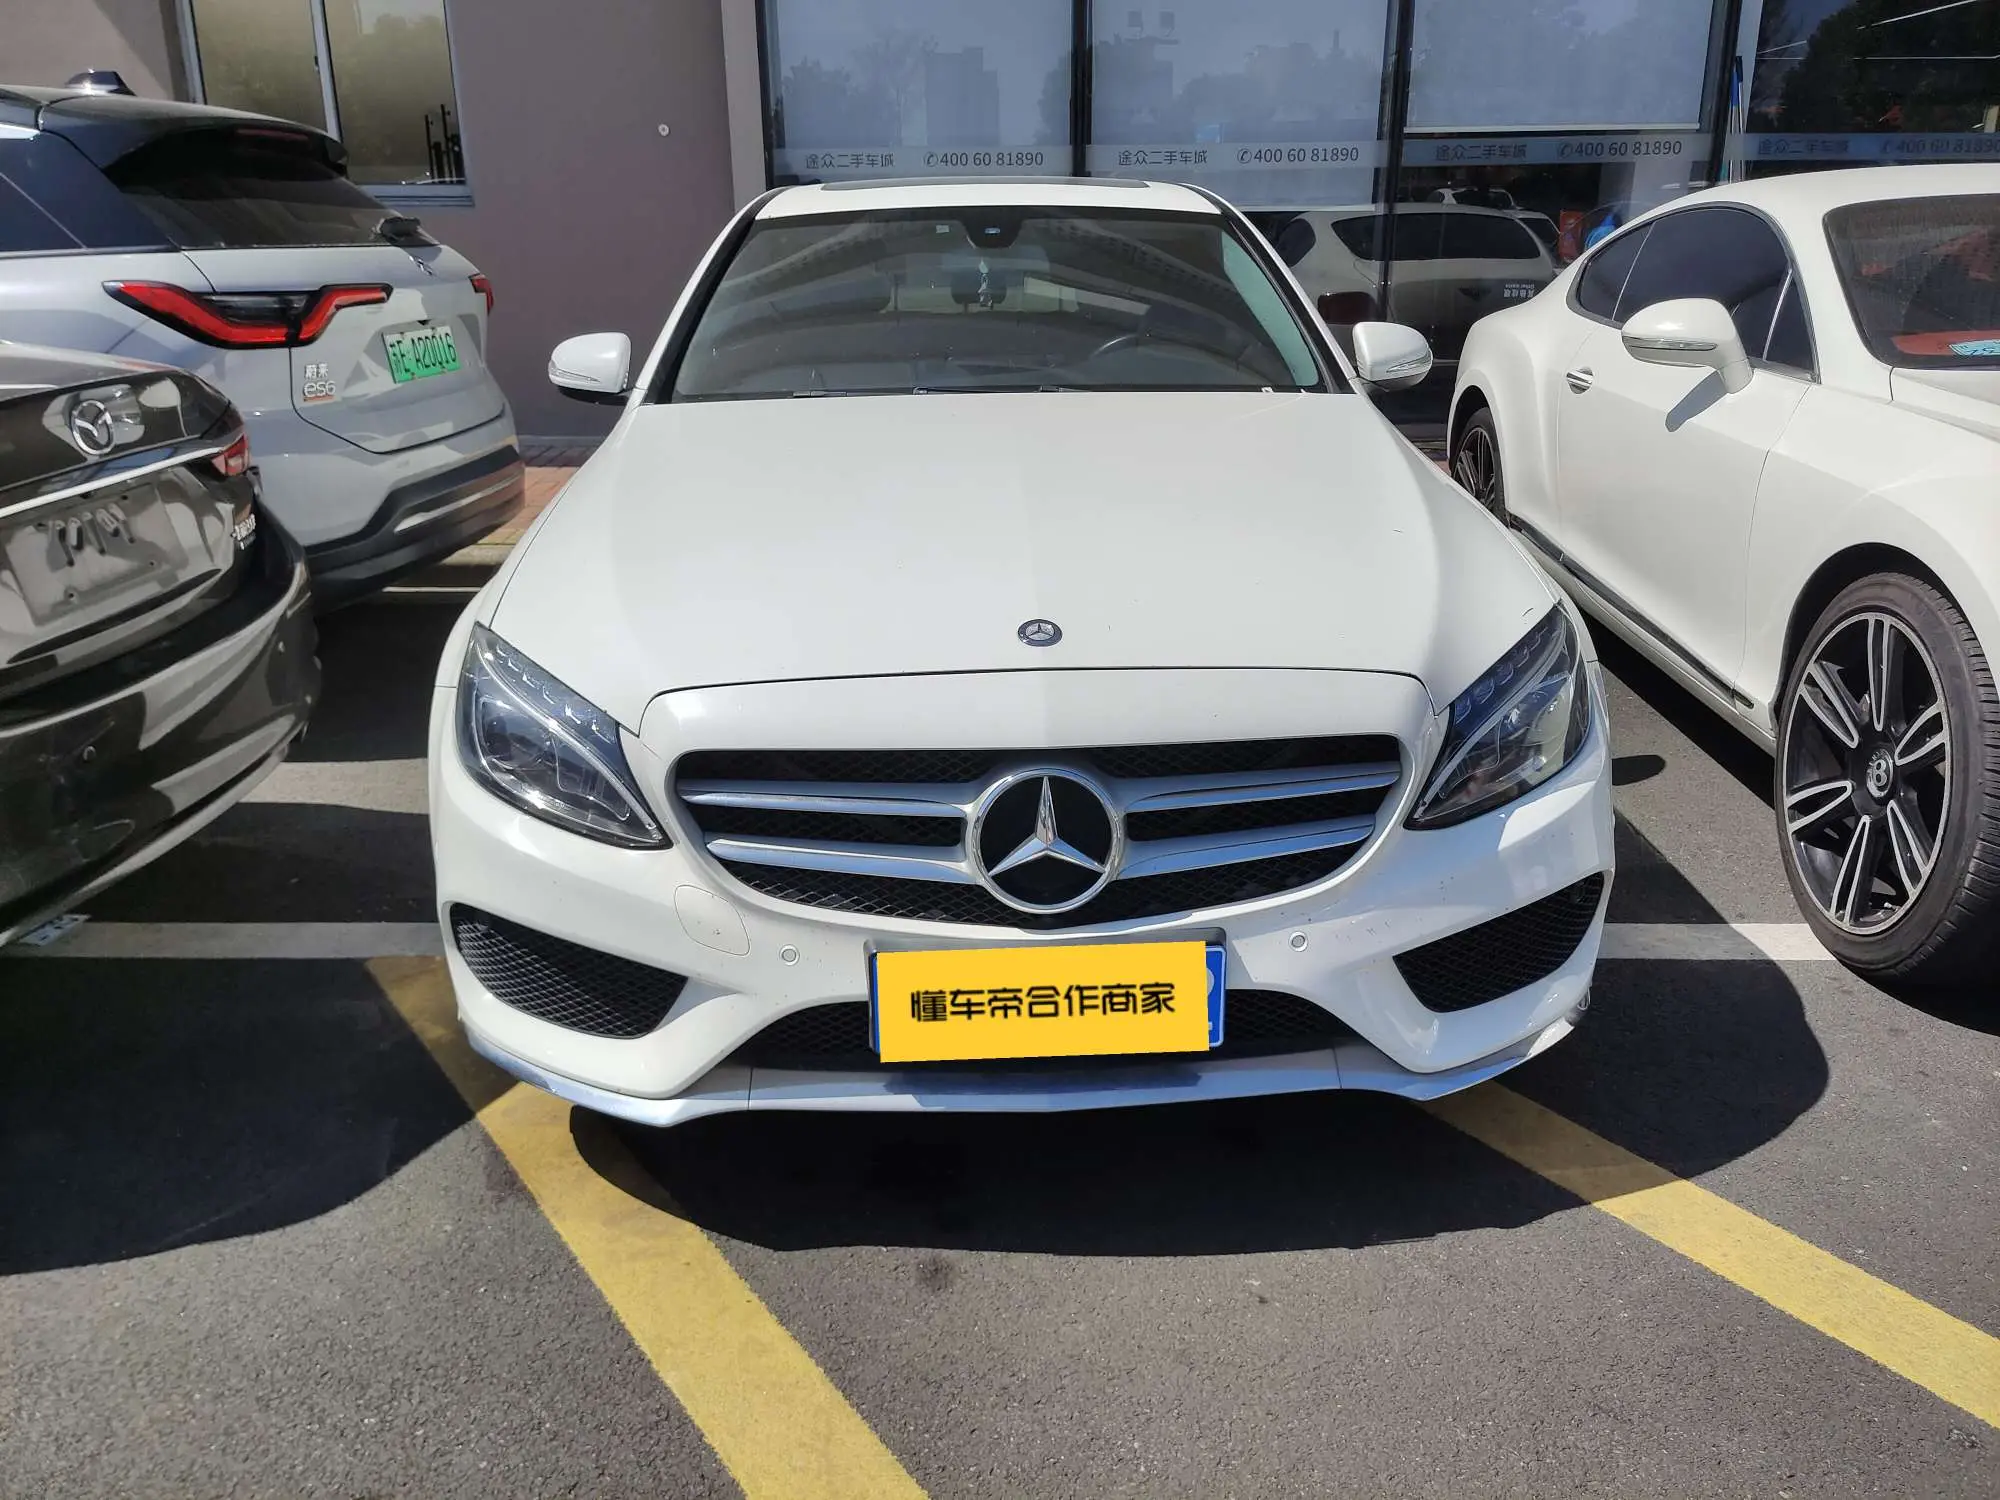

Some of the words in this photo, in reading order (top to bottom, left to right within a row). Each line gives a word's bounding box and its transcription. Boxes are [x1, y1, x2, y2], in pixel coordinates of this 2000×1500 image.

[1254, 149, 1282, 163] 400
[1287, 148, 1306, 162] 60
[1310, 147, 1359, 162] 81890
[1574, 142, 1604, 157] 400
[1608, 141, 1628, 157] 60
[1632, 140, 1682, 156] 81890
[805, 152, 894, 169] 途众二手车城
[940, 152, 968, 166] 400
[973, 152, 992, 166] 60
[996, 151, 1043, 166] 81890
[1118, 150, 1208, 166] 途众二手车城
